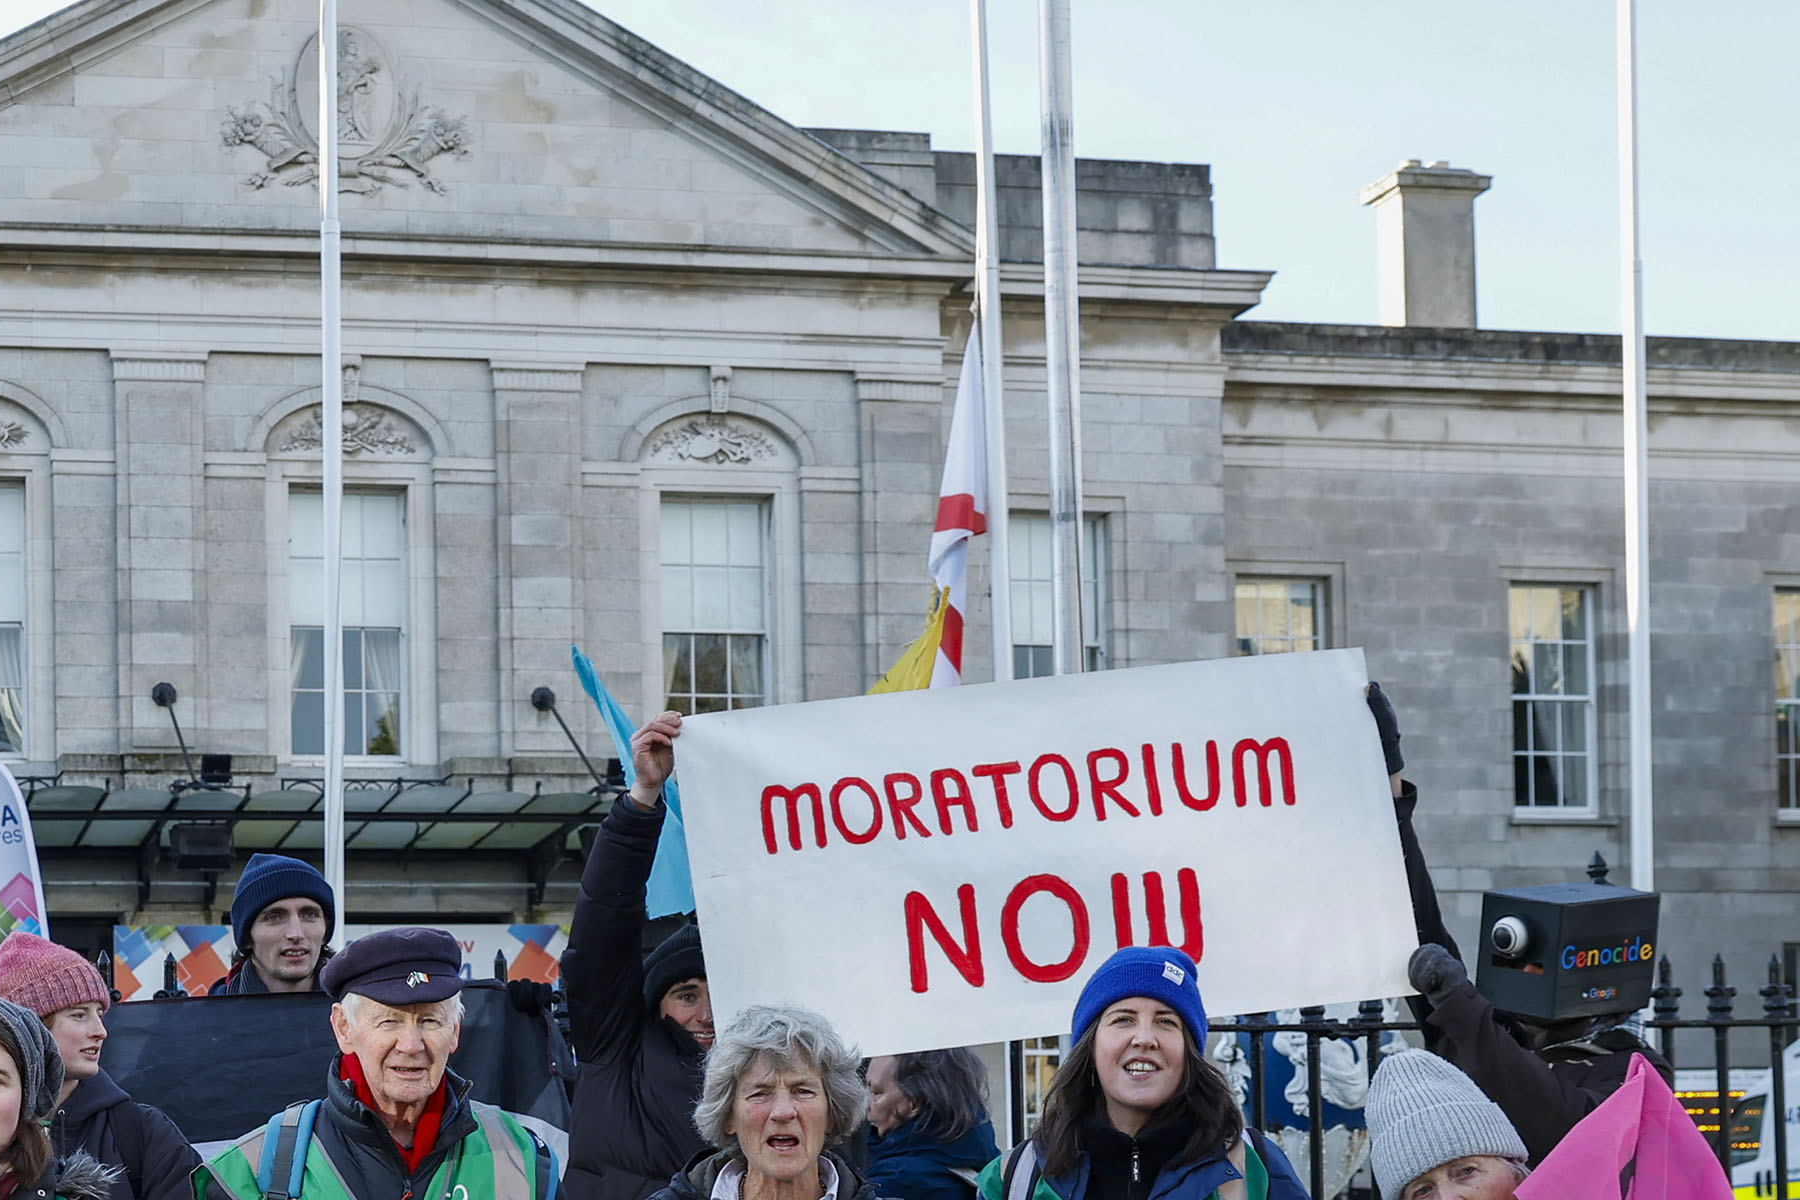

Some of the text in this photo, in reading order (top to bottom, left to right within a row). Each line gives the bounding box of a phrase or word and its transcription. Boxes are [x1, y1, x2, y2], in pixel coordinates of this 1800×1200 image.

[761, 736, 1296, 855] MORATORIUM
[904, 867, 1204, 994] NOW
[1560, 936, 1655, 970] Genocide
